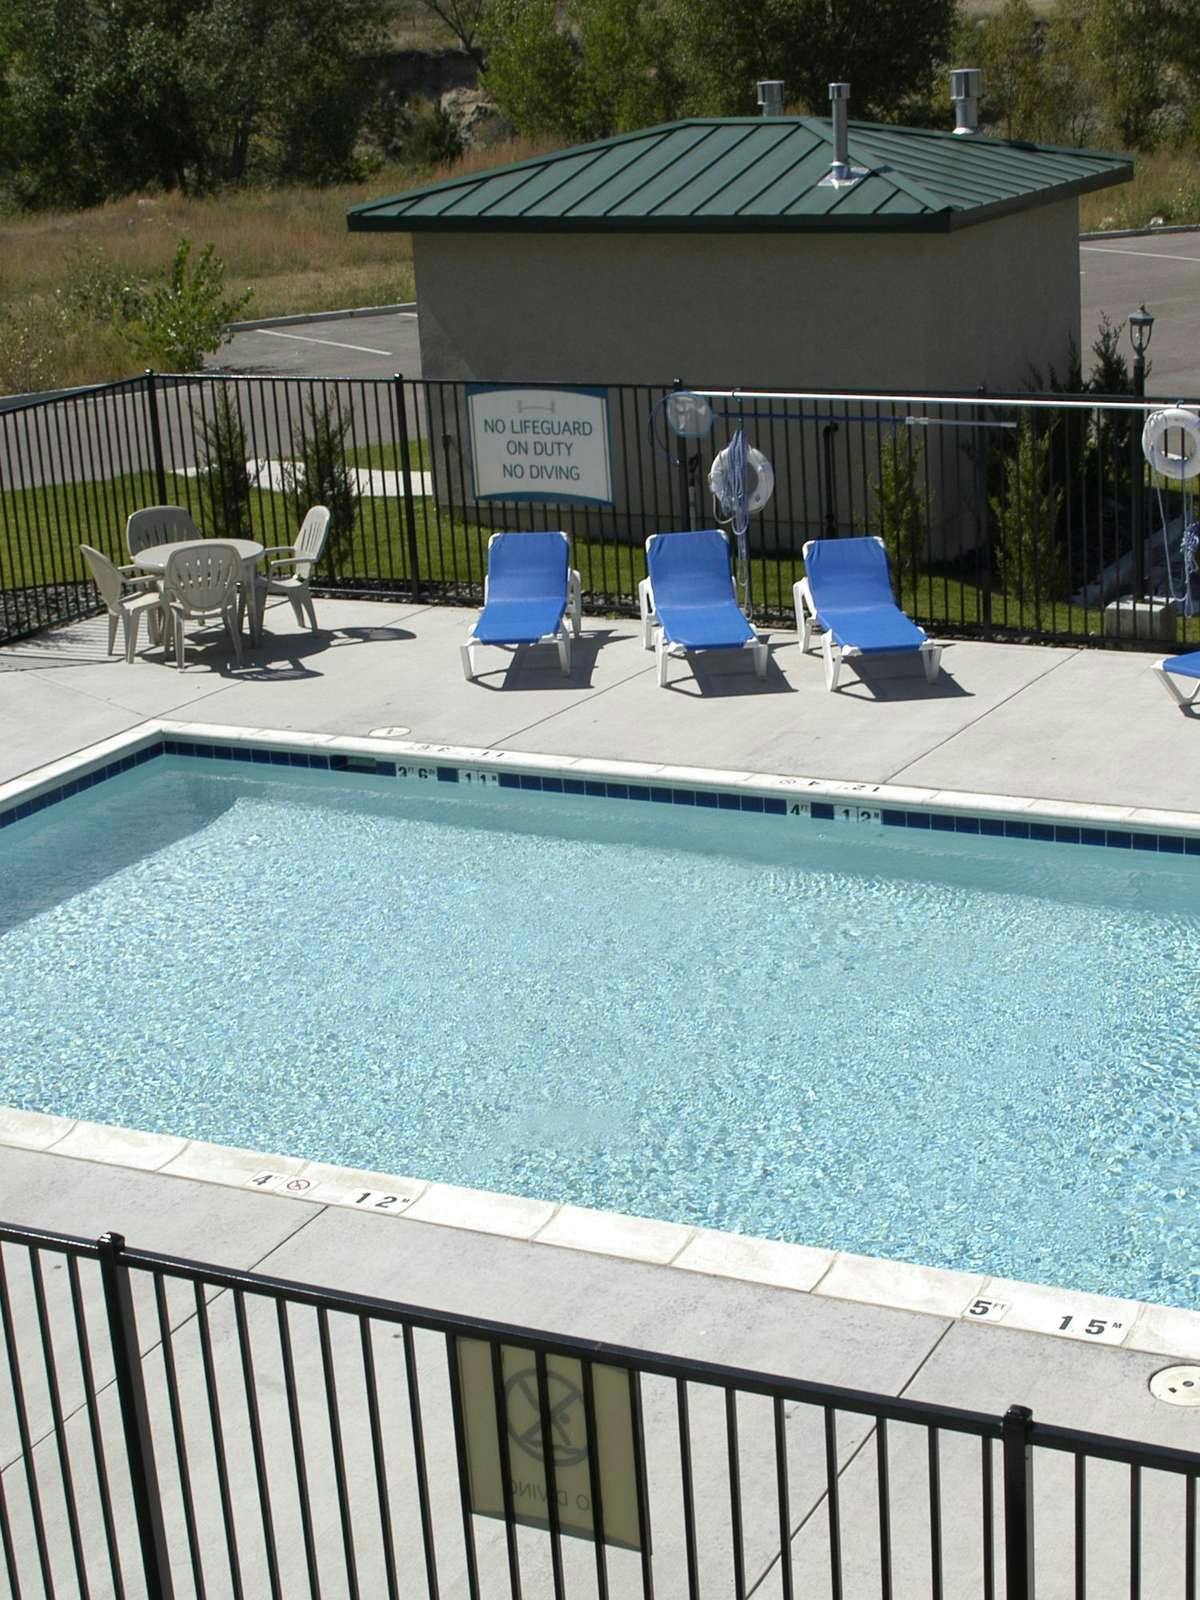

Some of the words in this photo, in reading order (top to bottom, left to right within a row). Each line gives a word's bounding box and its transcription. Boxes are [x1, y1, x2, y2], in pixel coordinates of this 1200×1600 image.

[484, 419, 506, 434] NO
[511, 420, 593, 436] LIFEGUARD
[506, 440, 529, 455] ON
[533, 441, 574, 456] DUTY
[503, 464, 525, 479] NO
[529, 465, 580, 481] DIVING
